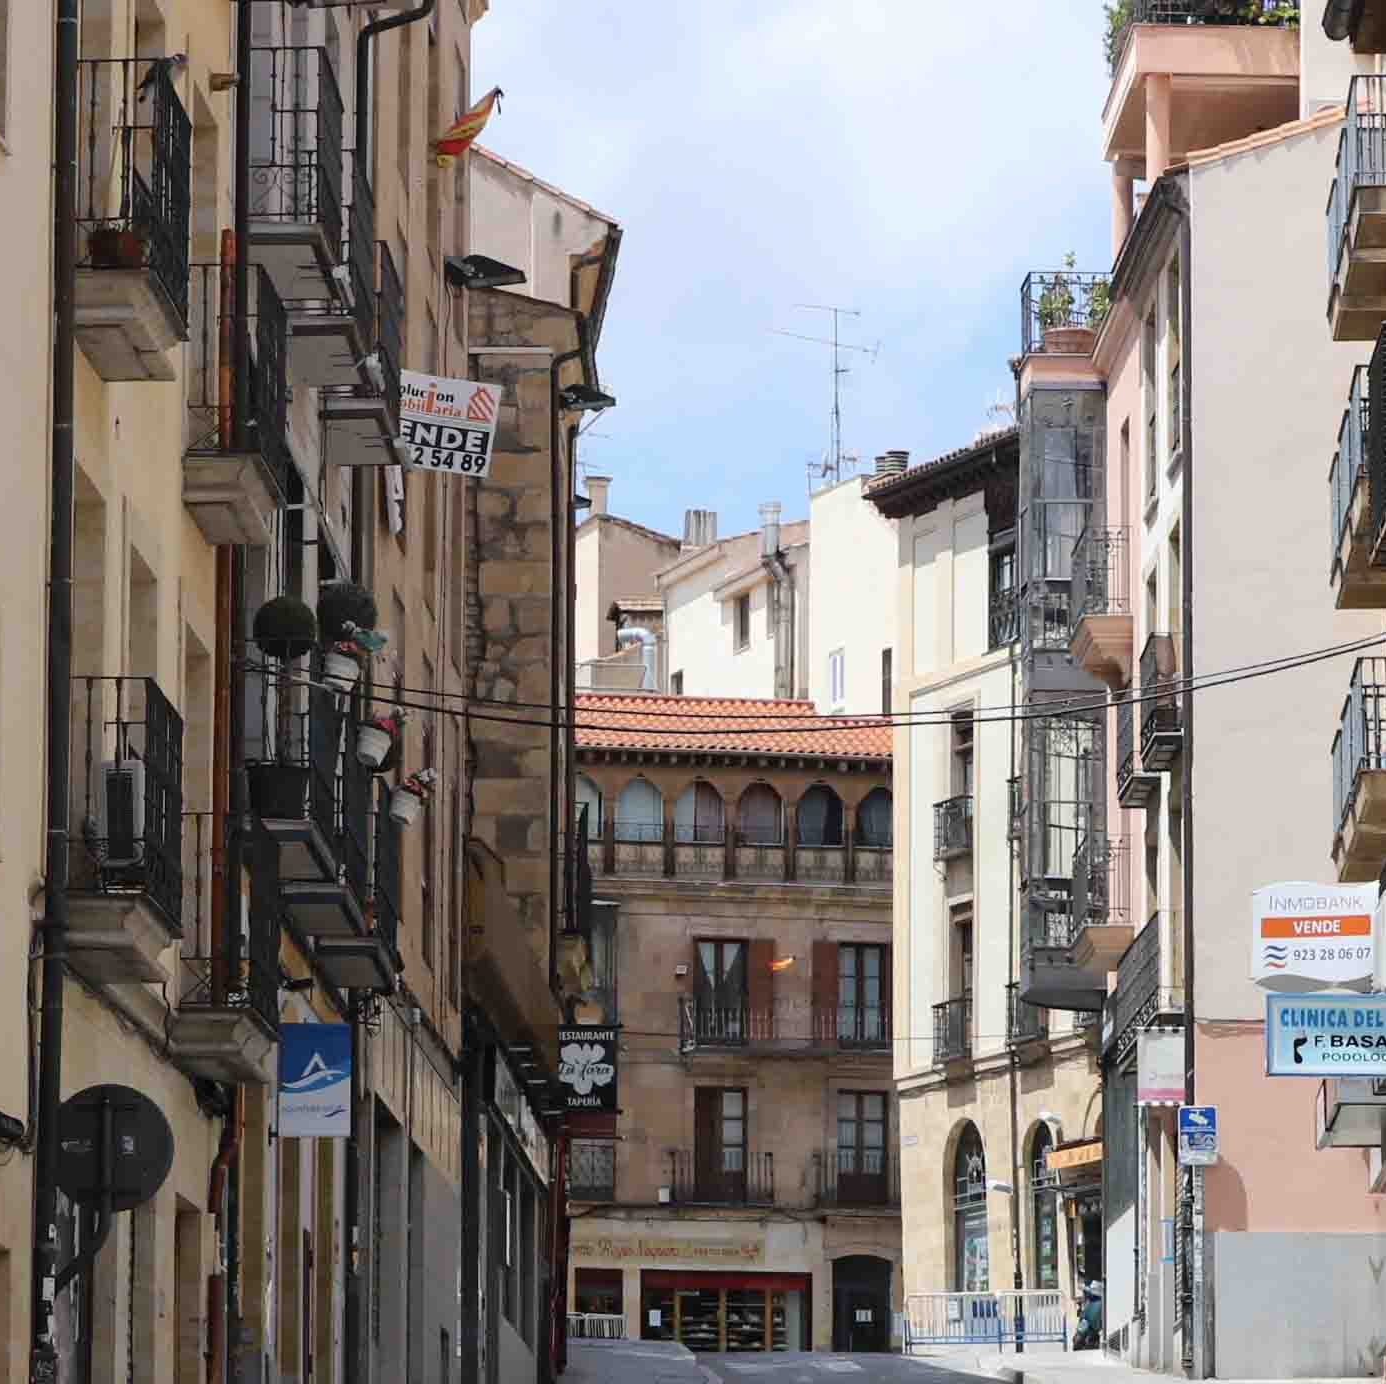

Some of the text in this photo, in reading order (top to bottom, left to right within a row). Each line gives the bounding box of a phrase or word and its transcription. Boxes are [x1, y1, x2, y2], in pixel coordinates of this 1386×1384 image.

[398, 382, 454, 403] olucion
[398, 396, 462, 416] obiliaria
[399, 421, 484, 453] ENDE
[431, 449, 454, 469] 54
[461, 454, 486, 473] 89
[1269, 894, 1364, 912] INMOBANK
[1292, 919, 1342, 935] VENDE
[1293, 947, 1371, 961] 923 28 06 07
[1280, 1007, 1349, 1028] CLINICA
[1353, 1008, 1384, 1028] DEL
